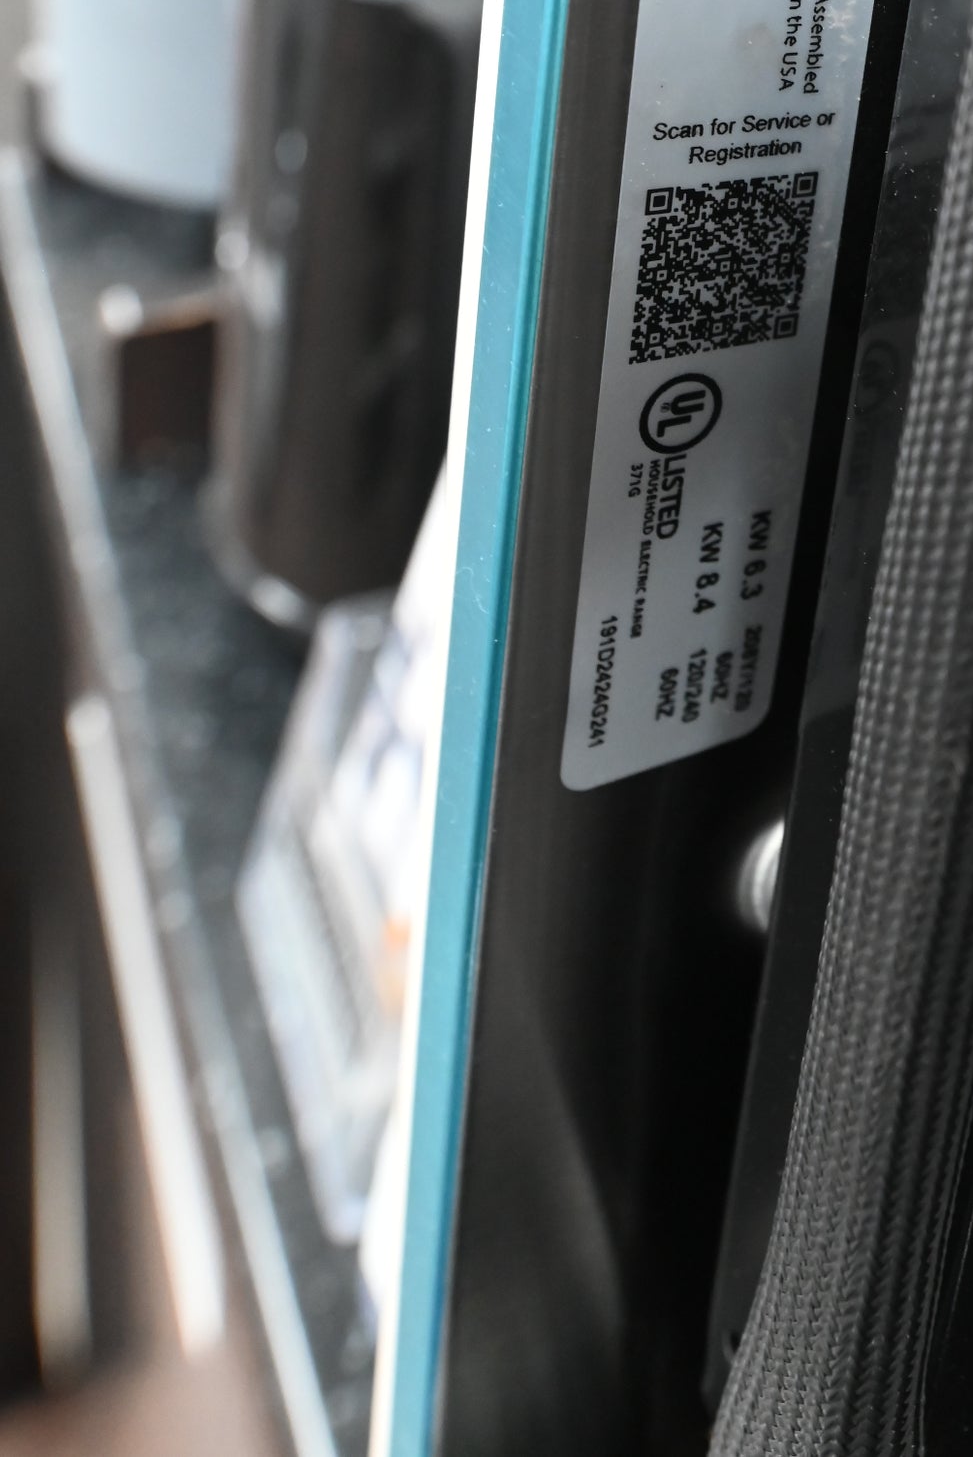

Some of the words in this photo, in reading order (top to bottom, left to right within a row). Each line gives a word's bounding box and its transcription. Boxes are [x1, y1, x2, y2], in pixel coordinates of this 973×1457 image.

[783, 15, 802, 47] the
[778, 52, 799, 92] USA
[653, 122, 704, 141] Scan
[710, 118, 737, 136] for
[741, 112, 812, 133] Service
[816, 111, 836, 126] or
[687, 139, 803, 166] Registration
[628, 462, 644, 498] 371G
[643, 458, 661, 536] HOUSEHOLD
[656, 453, 687, 540] LISTED
[699, 521, 724, 564] KW
[748, 509, 772, 551] KW
[635, 539, 652, 594] ELECTRIC
[740, 559, 767, 601] 6.3
[692, 572, 720, 615] 8.4
[629, 597, 646, 639] RANGE
[588, 615, 618, 748] 191D2424G241
[655, 667, 680, 721] 60HZ
[681, 648, 708, 724] 120/240
[710, 649, 734, 704] 60HZ
